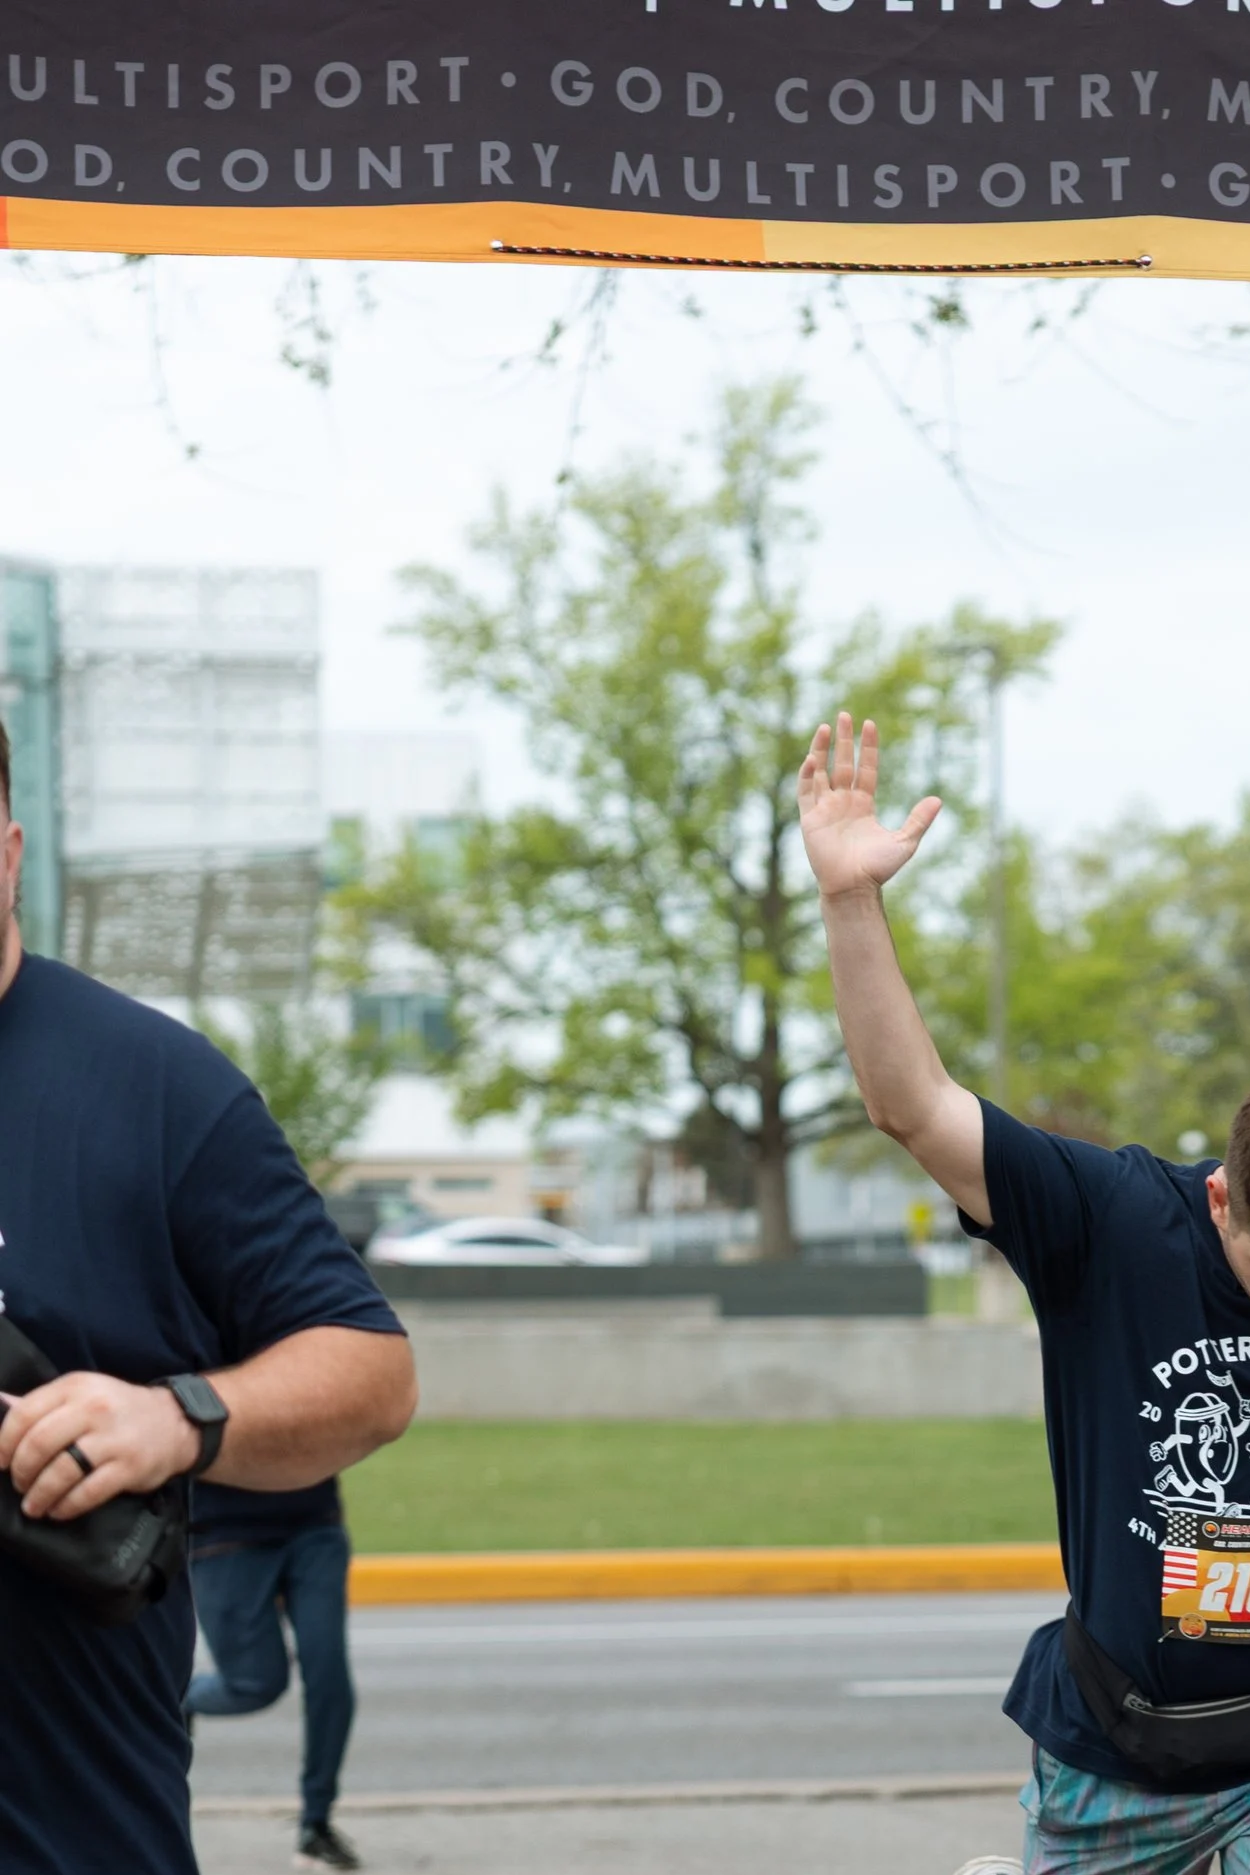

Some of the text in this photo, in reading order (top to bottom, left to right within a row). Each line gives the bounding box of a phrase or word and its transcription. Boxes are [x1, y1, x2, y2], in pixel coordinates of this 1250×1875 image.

[550, 59, 737, 124] GOD,
[776, 70, 1171, 126] COUNTRY,
[165, 141, 573, 194] COUNTRY,
[610, 152, 1131, 209] MULTISPORT
[1139, 1401, 1162, 1423] 20
[1127, 1517, 1157, 1545] 4TH
